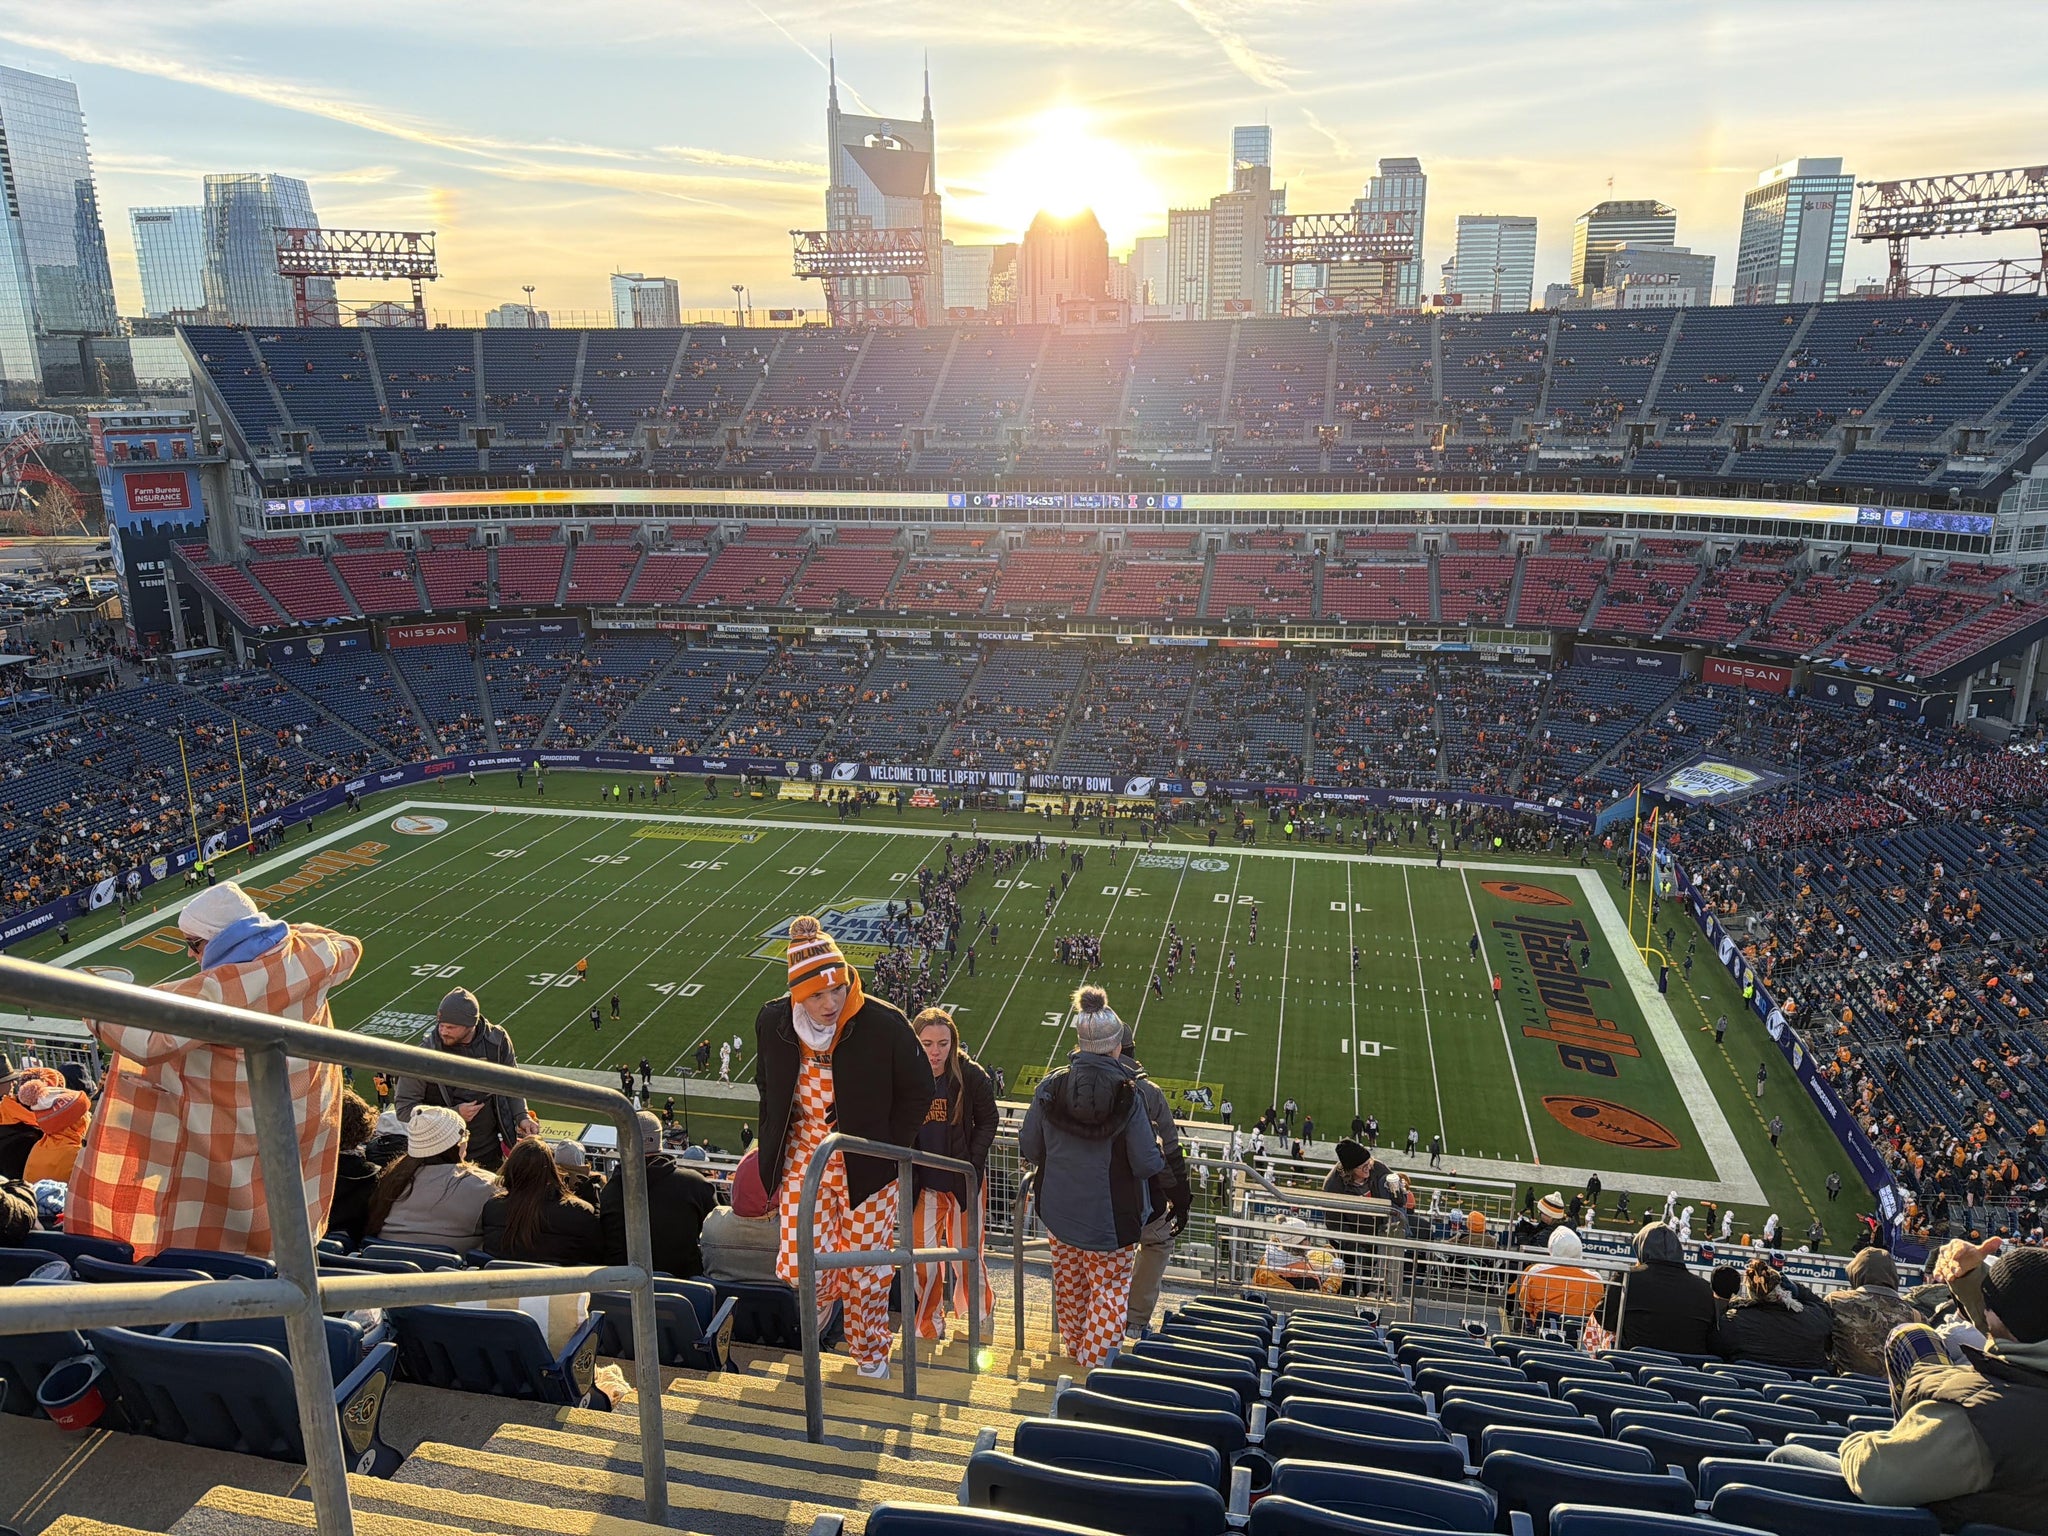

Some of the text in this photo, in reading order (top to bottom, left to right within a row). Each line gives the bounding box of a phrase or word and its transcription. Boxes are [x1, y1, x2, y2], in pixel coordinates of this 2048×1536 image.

[135, 494, 182, 502] INSURANCE
[973, 496, 982, 505] 0
[987, 494, 1000, 507] T
[1025, 496, 1054, 506] 34:53
[1147, 496, 1155, 506] 0
[268, 503, 286, 511] 3:58
[1860, 511, 1881, 520] 3:58
[136, 561, 155, 571] WE
[139, 579, 165, 587] TENN
[399, 626, 457, 639] NISSAN
[1168, 638, 1200, 646] Gallagher
[1714, 663, 1782, 682] NISSAN
[498, 756, 522, 764] DENTAL
[540, 754, 581, 762] BRIDGESTONE
[423, 761, 457, 774] ESPN
[869, 765, 1114, 792] WELCOME TO THE LIBERTY MUTU MUSIC CITY BOWL
[1680, 768, 1716, 781] MUSIC
[1716, 776, 1745, 790] CITY
[1684, 775, 1718, 790] BOWL
[4, 912, 54, 938] DELTA DENTAL
[789, 943, 832, 965] VOLUNT
[411, 963, 466, 979] 20
[820, 966, 836, 985] T
[528, 972, 582, 988] 30
[654, 982, 706, 998] 40
[1491, 914, 1641, 1078] Nashville
[369, 1016, 429, 1029] BOWL
[1180, 1023, 1233, 1043] 20
[1341, 1038, 1381, 1057] 10
[1264, 1205, 1312, 1218] permobil
[1581, 1243, 1631, 1255] permobil
[1712, 1256, 1750, 1270] permo
[1782, 1264, 1836, 1279] permobil
